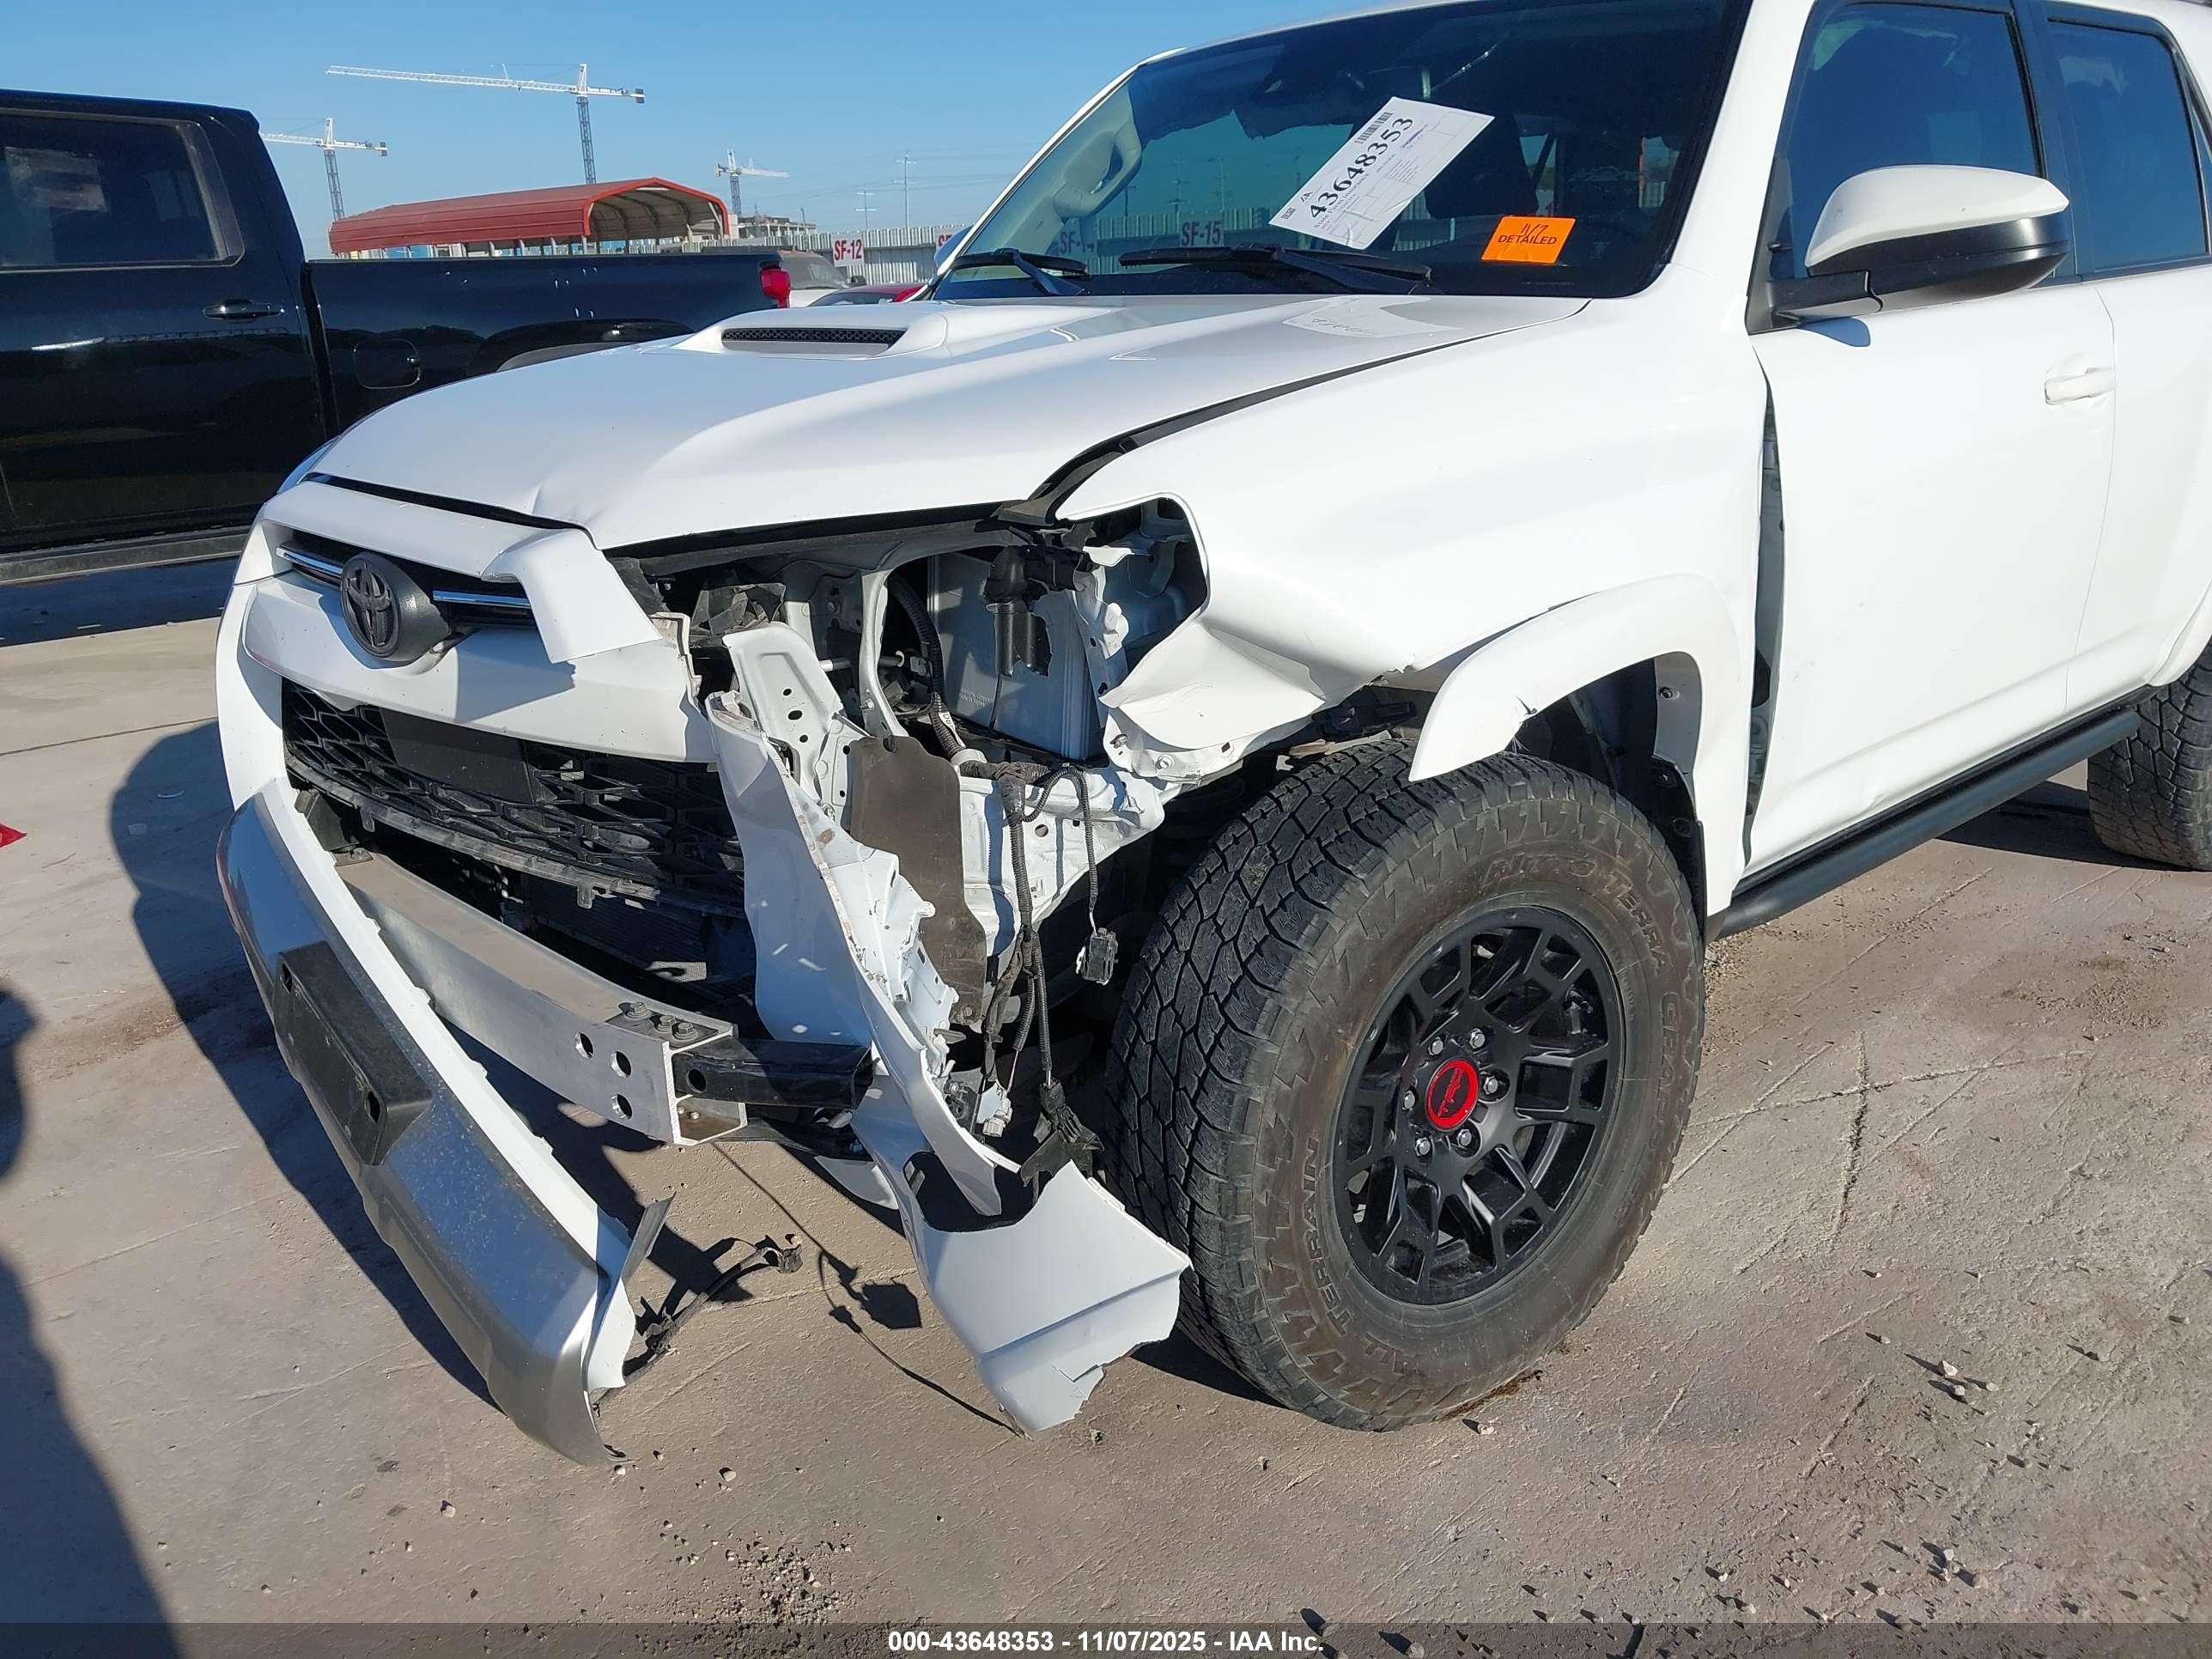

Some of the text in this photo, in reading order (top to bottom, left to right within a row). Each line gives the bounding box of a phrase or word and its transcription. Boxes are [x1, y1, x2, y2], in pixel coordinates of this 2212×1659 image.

[1308, 116, 1414, 219] 43648353
[1182, 220, 1221, 246] SF-15
[1498, 234, 1558, 245] DETAILED
[834, 238, 862, 261] SF-12
[1300, 1136, 1352, 1338] TERRAIN
